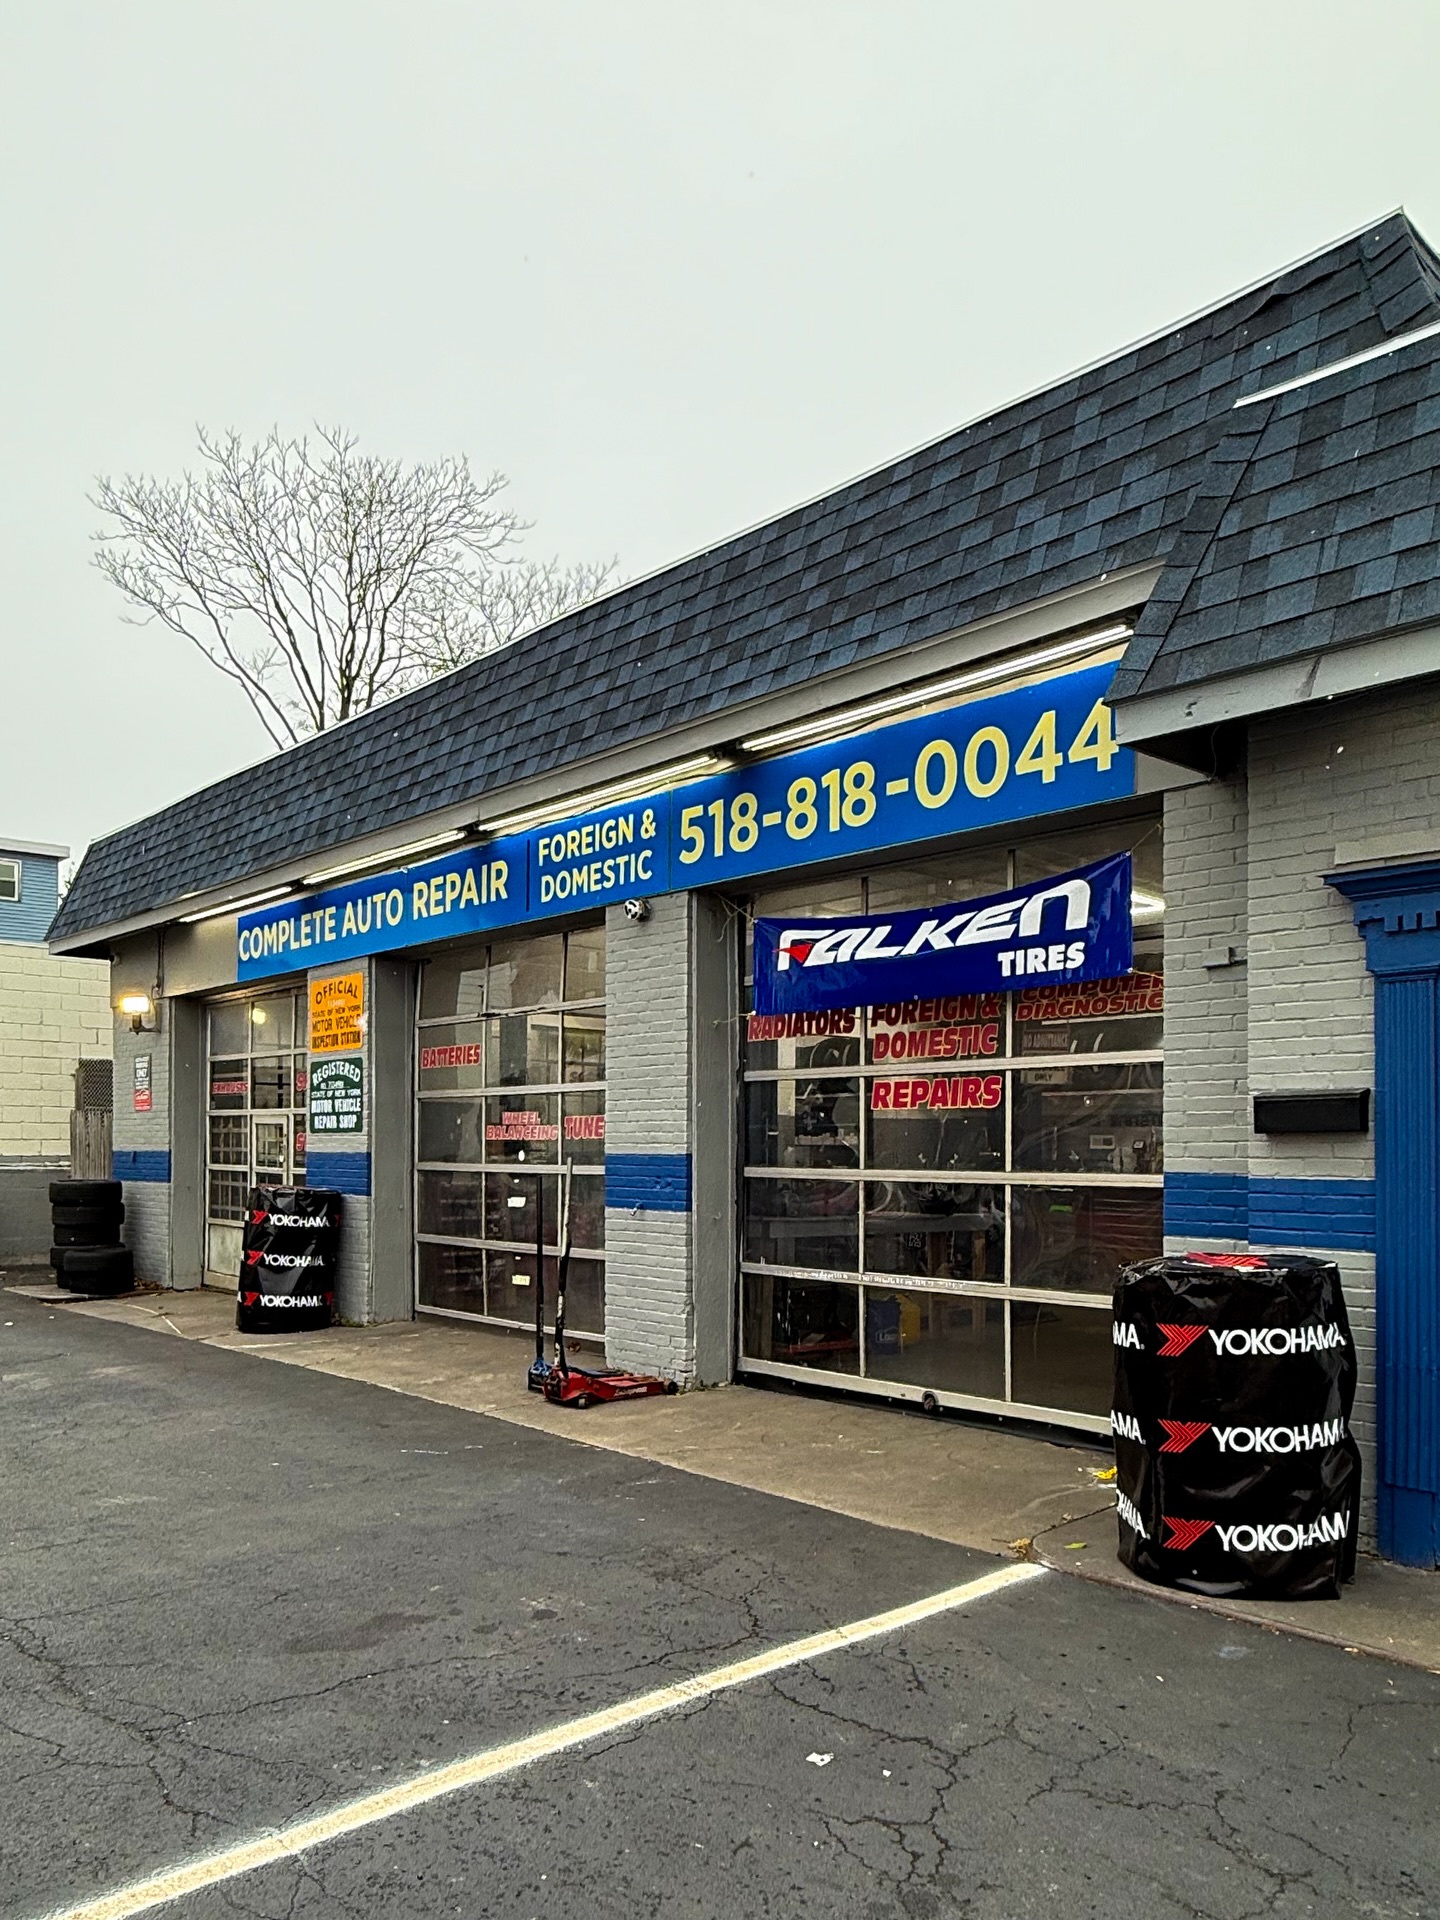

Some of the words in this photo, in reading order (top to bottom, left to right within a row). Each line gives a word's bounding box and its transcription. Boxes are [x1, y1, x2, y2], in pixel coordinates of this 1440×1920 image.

[679, 697, 1119, 864] 518-818-0044
[538, 814, 634, 867] FOREIGN
[640, 809, 657, 840] &
[540, 850, 653, 903] DOMESTIC
[239, 906, 337, 962] COMPLETE
[341, 889, 404, 938] AUTO
[413, 861, 509, 920] REPAIR
[775, 879, 1091, 971] FALKEN
[997, 942, 1086, 976] TIRES
[315, 980, 358, 1004] OFFICIAL
[312, 1018, 333, 1032] MOTOR
[748, 1007, 856, 1042] RADIATORS
[871, 995, 976, 1027] FOREIGN
[981, 992, 999, 1019] &
[312, 1033, 339, 1049] INSPECTION
[340, 1030, 361, 1046] STATION
[421, 1044, 481, 1069] BATTERIES
[873, 1024, 999, 1062] DOMESTIC
[312, 1061, 361, 1086] REGISTERED
[311, 1100, 333, 1113] MOTOR
[335, 1098, 361, 1112] VEHICLE
[871, 1076, 1003, 1110] REPAIRS
[314, 1115, 337, 1129] REPAIR
[339, 1114, 357, 1128] SHOP
[502, 1111, 541, 1125] WHEEL
[565, 1115, 605, 1140] TUNE
[1208, 1321, 1346, 1355] YOKOHAMA
[1214, 1510, 1350, 1552] YOKOHAM
